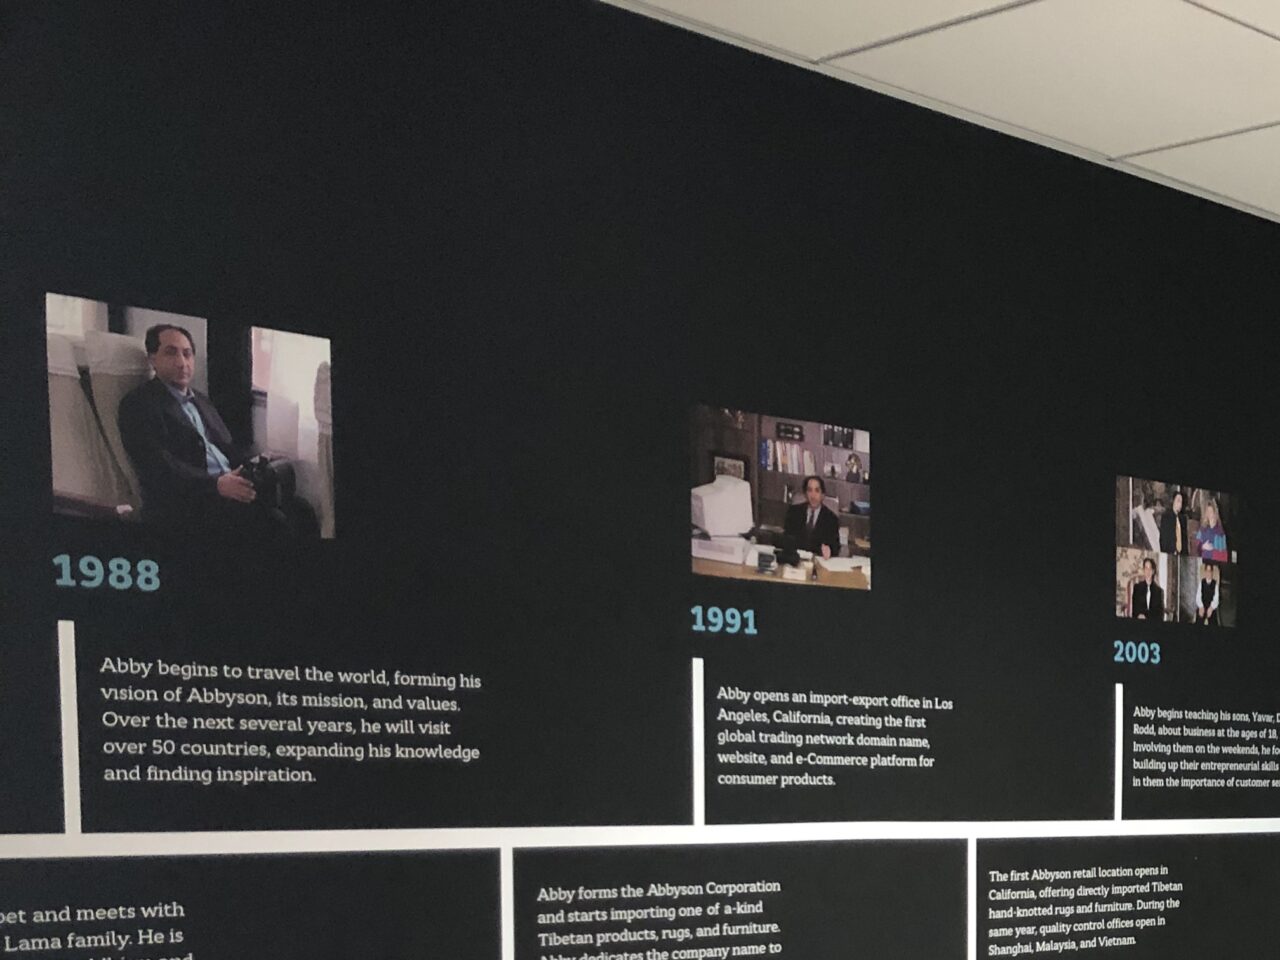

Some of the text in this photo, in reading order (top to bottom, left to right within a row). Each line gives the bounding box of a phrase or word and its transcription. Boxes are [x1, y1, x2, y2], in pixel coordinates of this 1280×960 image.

[52, 554, 160, 591] 1988
[691, 605, 757, 634] 1991
[1114, 640, 1160, 664] 2003
[100, 657, 481, 691] Abby begins to travel the world, forming his
[100, 685, 460, 711] vision of Abbyson, its mission, and values.
[716, 686, 952, 709] Abby opens an import-export office in Los
[717, 708, 926, 729] Angeles, California, creating the first
[1133, 706, 1156, 720] Abby
[1157, 706, 1183, 721] begins
[1184, 709, 1218, 723] teaching
[1220, 710, 1230, 720] his
[1232, 713, 1250, 722] sons,
[1252, 712, 1274, 723] Yavar,
[717, 729, 930, 748] global trading network domain name,
[1133, 741, 1171, 755] Involving
[1172, 742, 1193, 753] them
[1195, 745, 1205, 753] on
[1207, 743, 1220, 753] the
[1221, 744, 1260, 755] weekends,
[1261, 744, 1270, 754] he
[103, 739, 480, 762] over 50 countries, expanding his knowledge
[717, 750, 934, 769] website, and e-Commerce platform for
[104, 765, 316, 785] and finding inspiration.
[717, 772, 835, 788] consumer products.
[988, 865, 1168, 882] The first Abbyson retail location opens in
[537, 880, 780, 903] Abby forms the Abbyson Corporation
[988, 881, 1182, 900] California, offering directly imported Tibetan
[33, 906, 70, 922] and
[76, 906, 135, 920] meets
[140, 901, 184, 917] with
[988, 898, 1180, 919] hand-knotted rugs and furniture. During the
[4, 928, 183, 952] Lama family. He is
[538, 922, 780, 946] Tibetan products, rugs, and furniture.
[646, 948, 669, 960] the
[671, 947, 730, 960] company
[732, 944, 766, 956] name
[768, 943, 782, 953] to
[988, 942, 1034, 956] Shanghai,
[1036, 939, 1078, 953] Malaysia,
[1080, 937, 1096, 948] and
